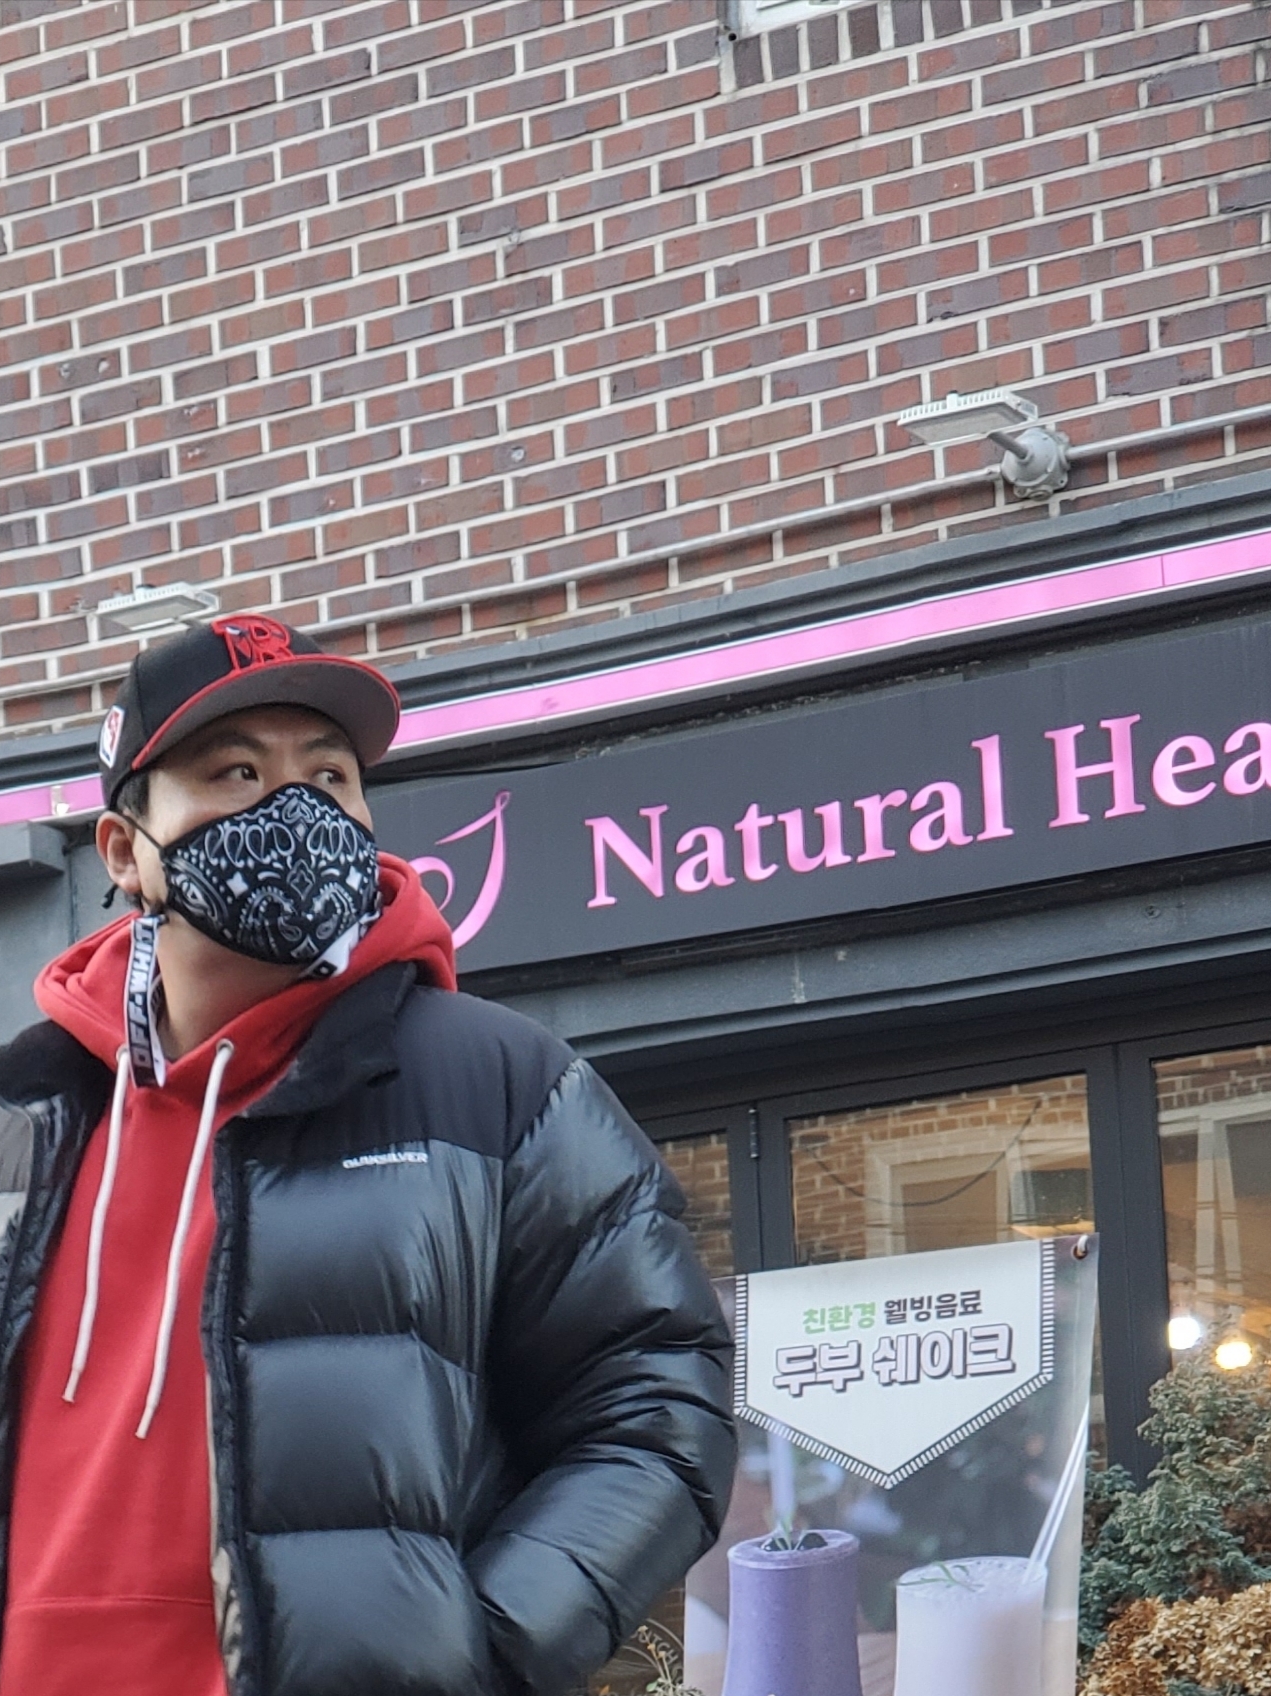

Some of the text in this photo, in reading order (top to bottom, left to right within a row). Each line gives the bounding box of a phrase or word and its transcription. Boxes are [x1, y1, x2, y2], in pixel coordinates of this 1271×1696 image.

[585, 733, 1015, 909] Natural
[802, 1288, 983, 1335] 친환경 웰빙음료
[772, 1322, 1016, 1398] 두부 쉐이크
